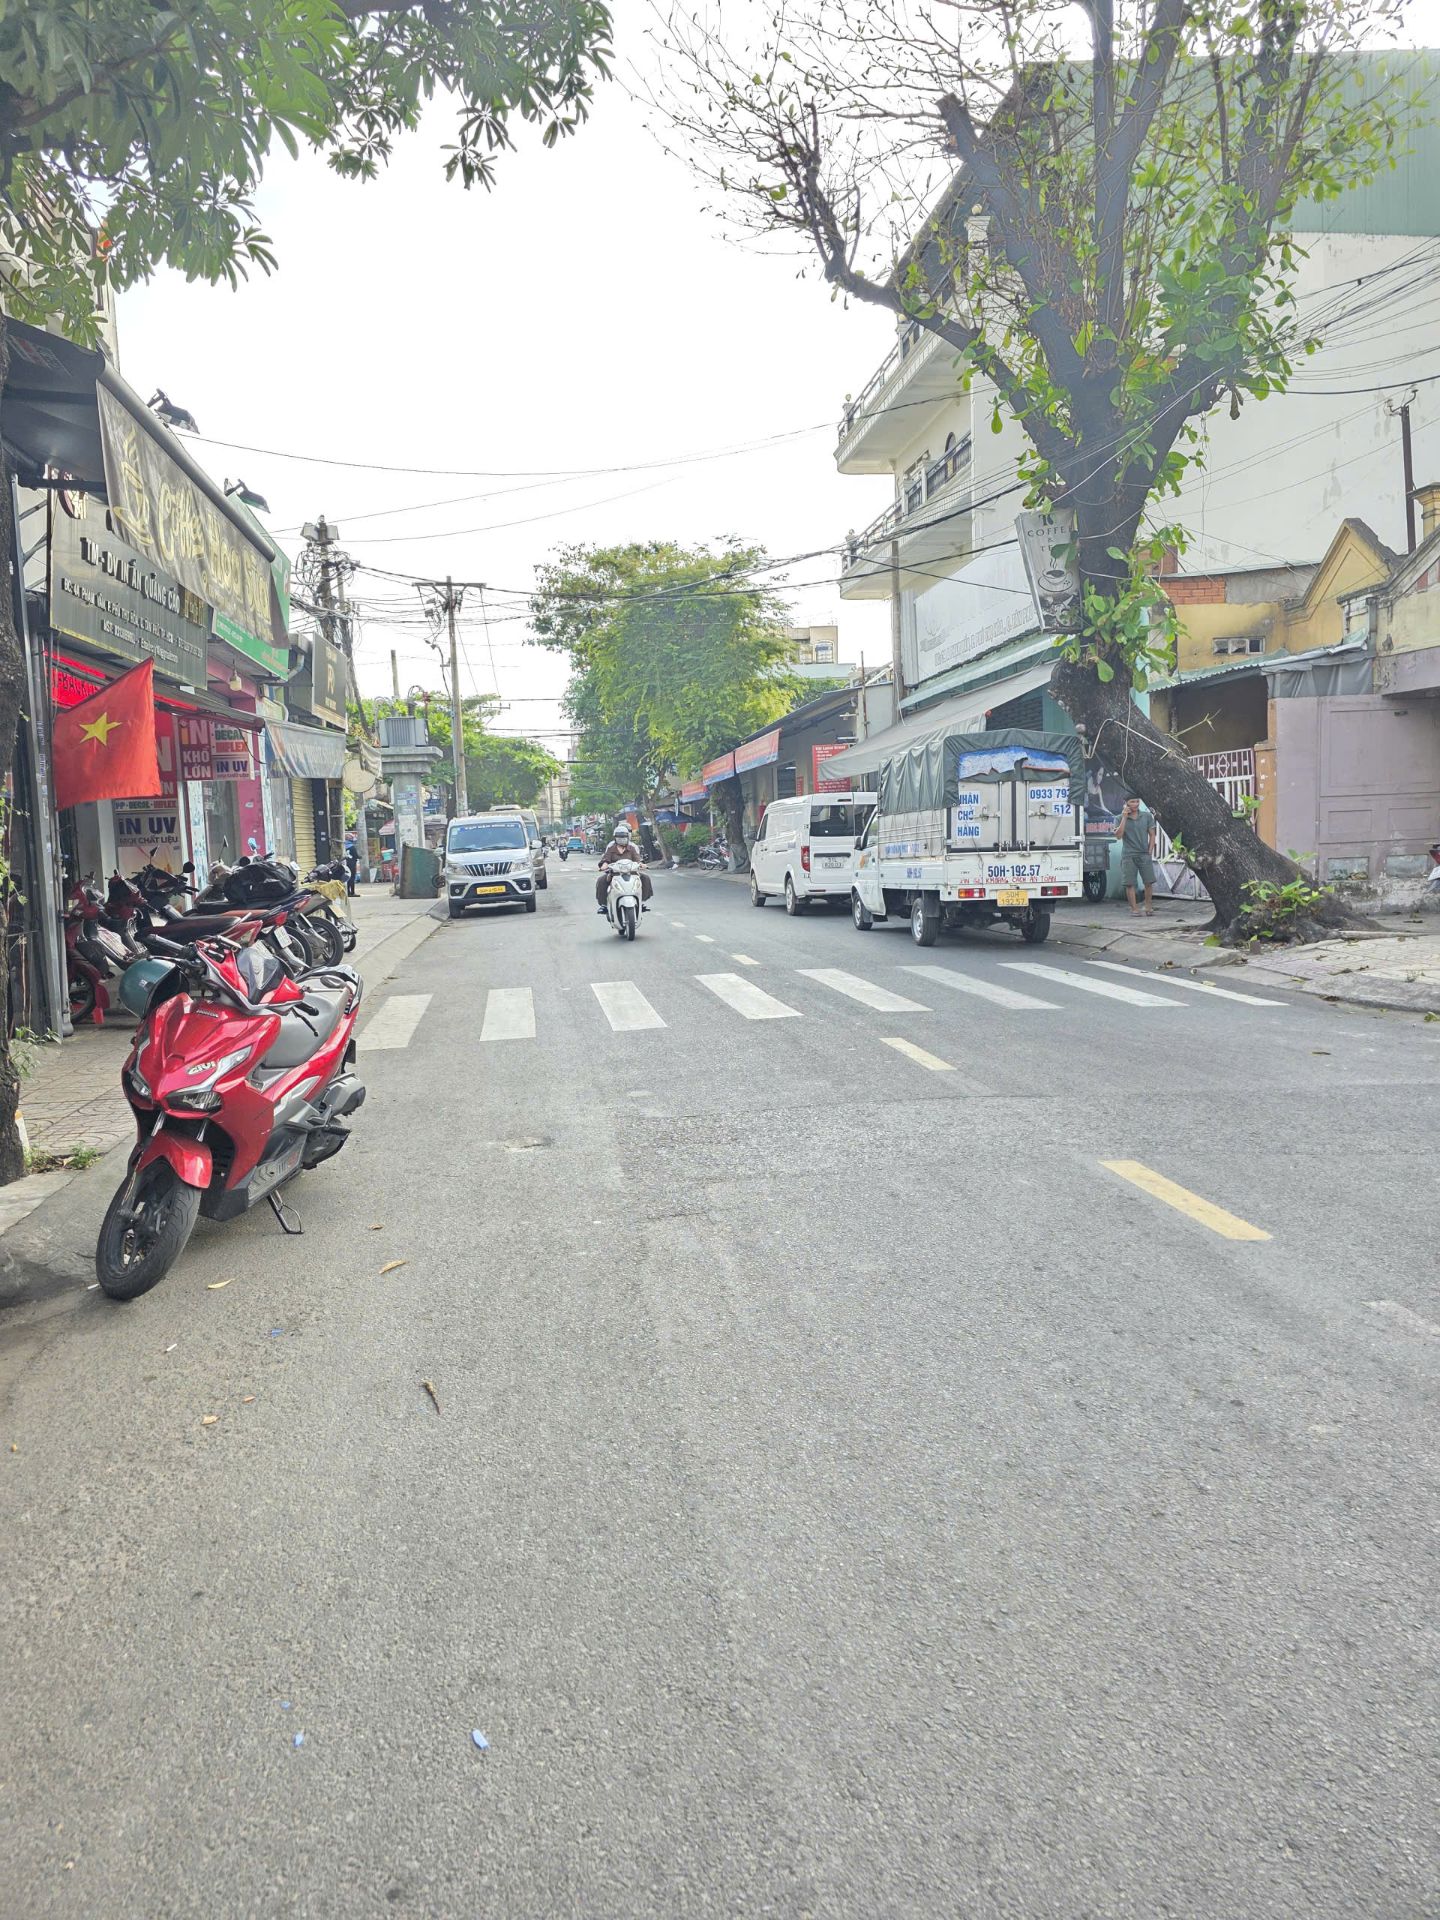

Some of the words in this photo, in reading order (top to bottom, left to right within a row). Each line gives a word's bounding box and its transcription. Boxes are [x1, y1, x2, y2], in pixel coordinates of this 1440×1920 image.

[1030, 788, 1053, 799] 0933
[1053, 803, 1071, 814] 512
[148, 816, 177, 834] UV
[988, 864, 1041, 877] 50H-192.57
[187, 1060, 216, 1075] GIVI
